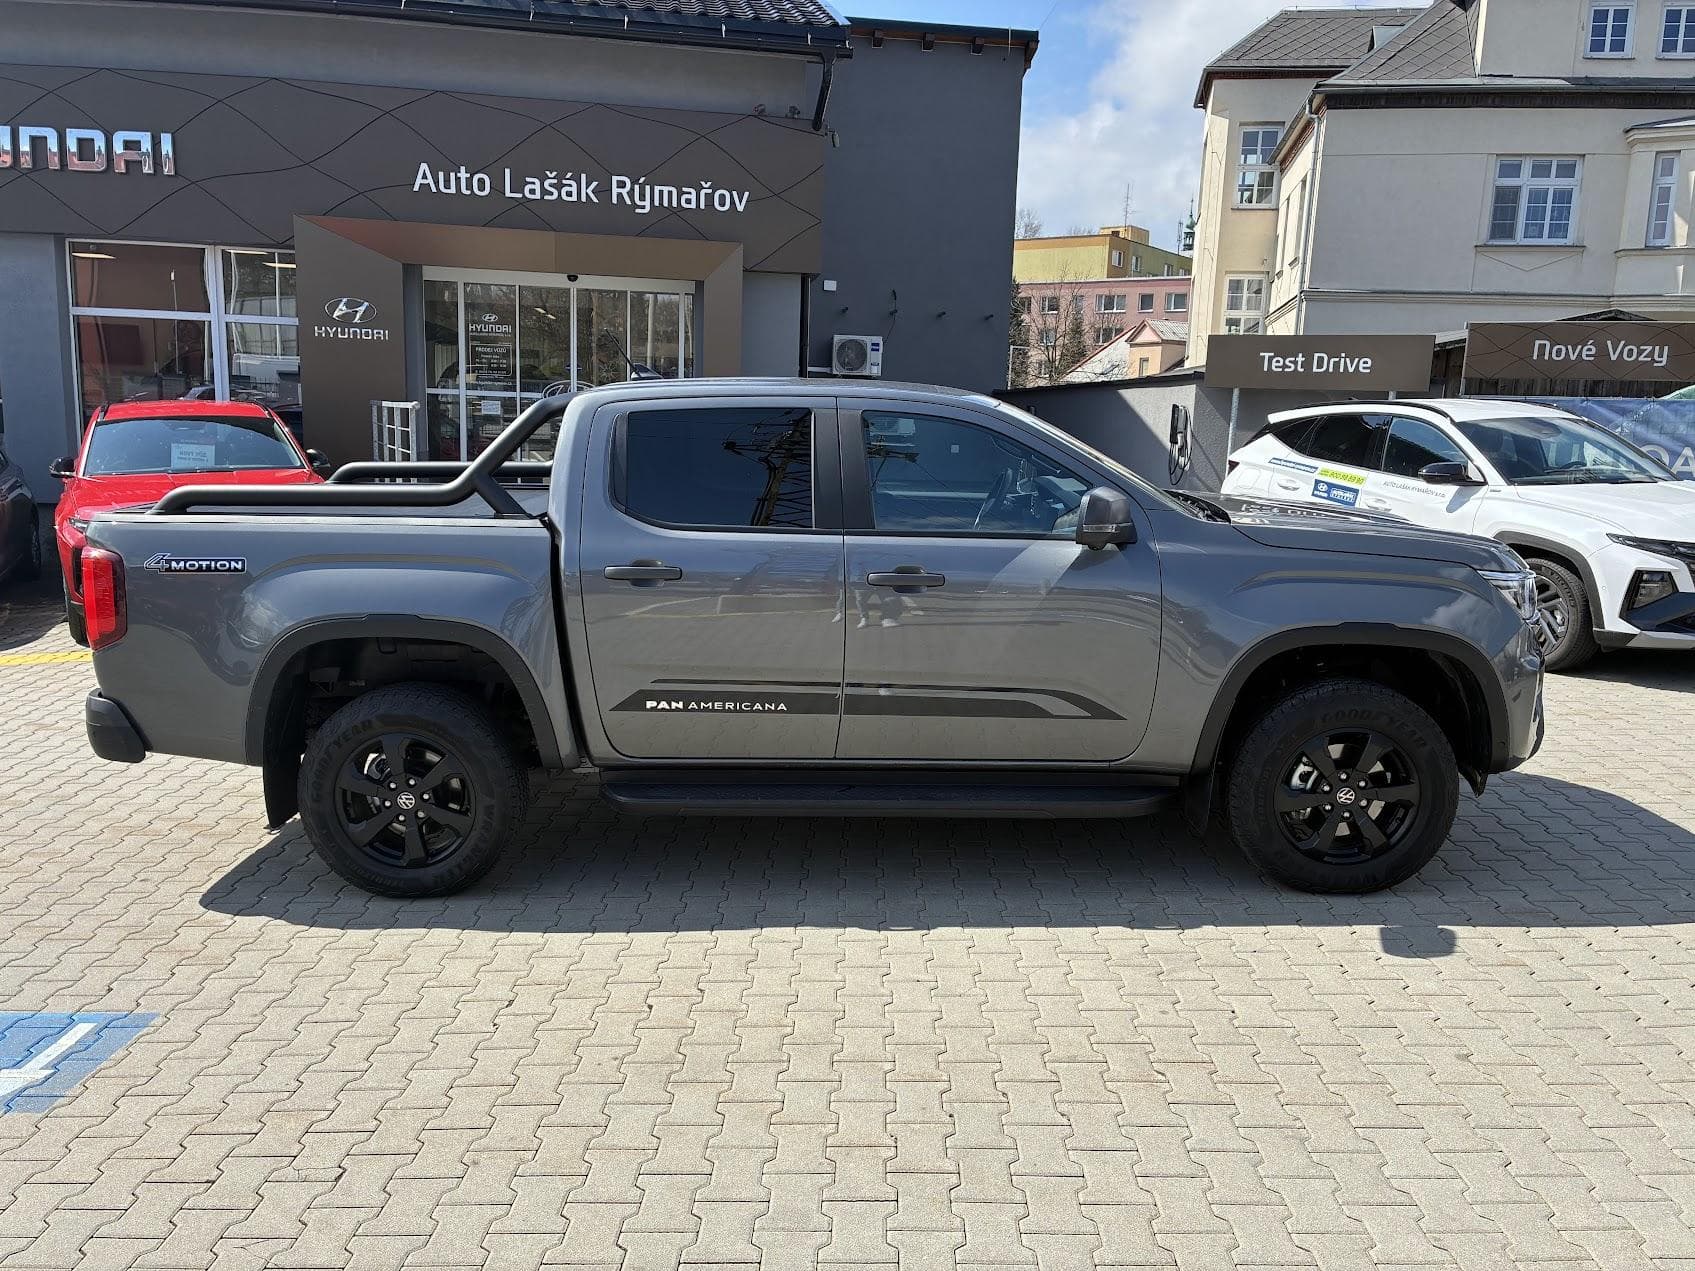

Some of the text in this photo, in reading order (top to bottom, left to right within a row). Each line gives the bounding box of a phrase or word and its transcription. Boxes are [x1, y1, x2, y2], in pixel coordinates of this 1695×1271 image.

[413, 162, 750, 214] Auto Lašák Rýmařov
[314, 325, 389, 341] HYUNDAI
[469, 323, 512, 333] HYUNDAI
[1532, 338, 1669, 366] Nové Vozy
[1259, 352, 1373, 374] Test Drive
[645, 700, 788, 711] PAN AMERICANA
